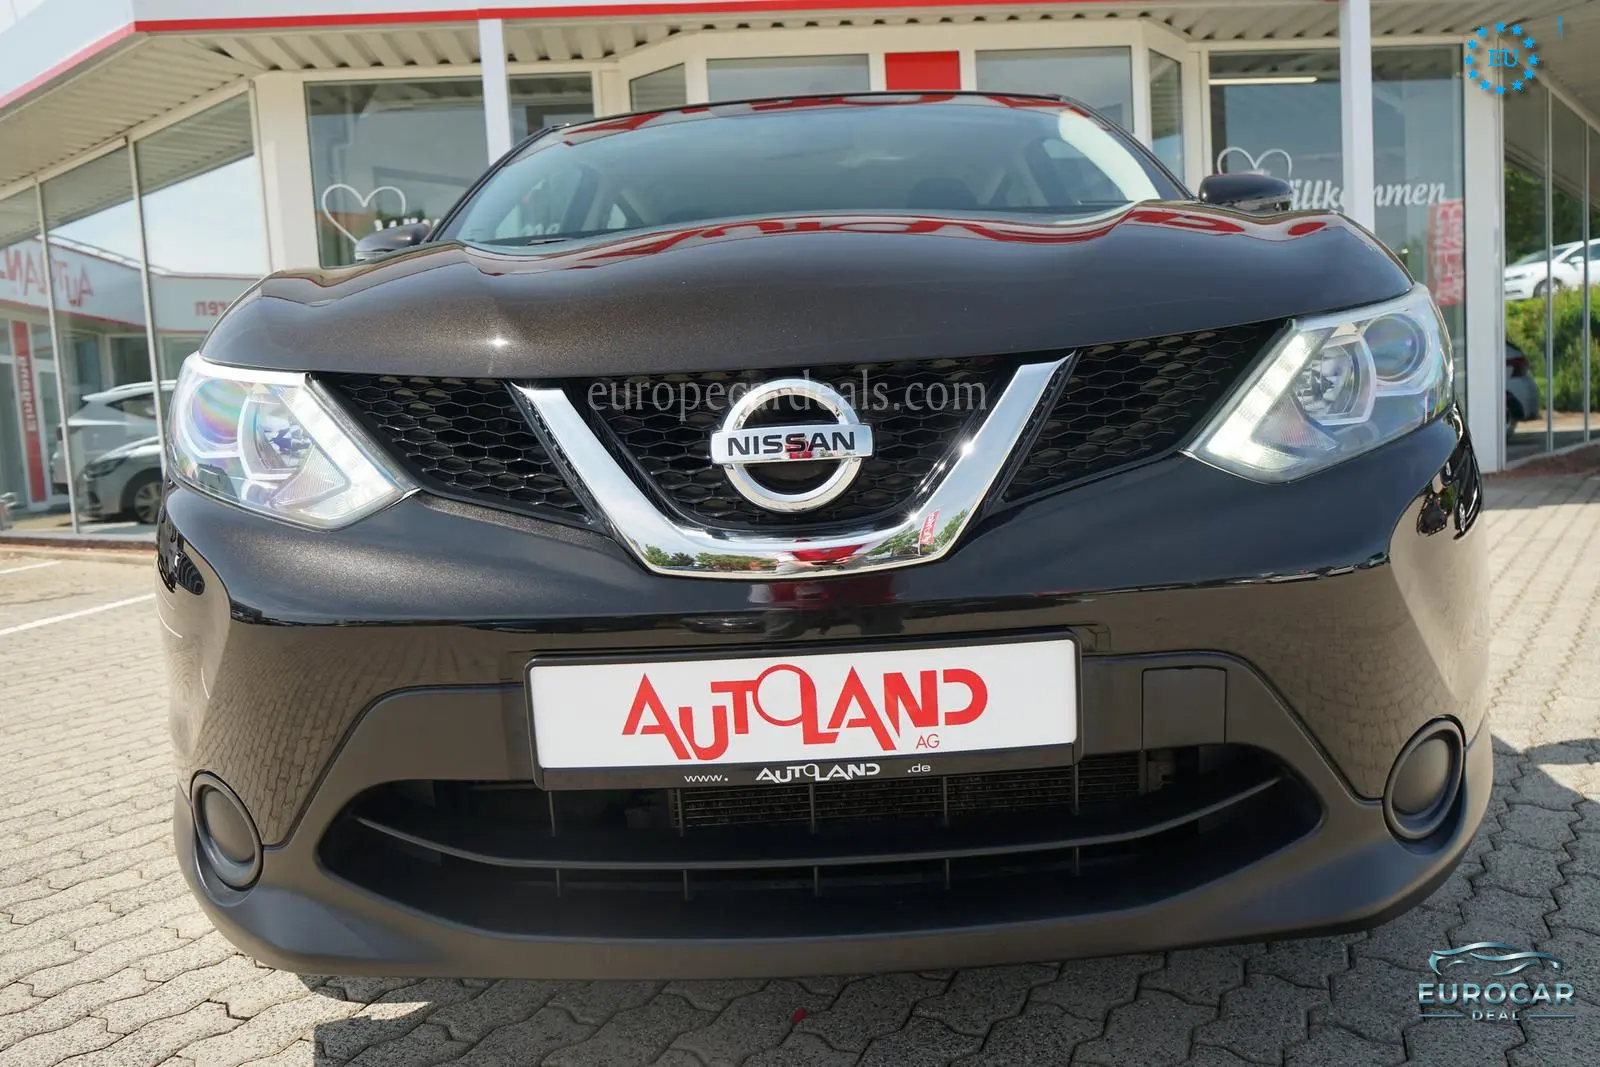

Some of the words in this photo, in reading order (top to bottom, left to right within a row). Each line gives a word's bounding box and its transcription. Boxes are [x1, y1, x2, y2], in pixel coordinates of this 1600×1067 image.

[1288, 178, 1448, 212] illkmmen
[727, 430, 855, 456] NISSAN
[915, 733, 940, 749] AG
[907, 762, 932, 774] .de
